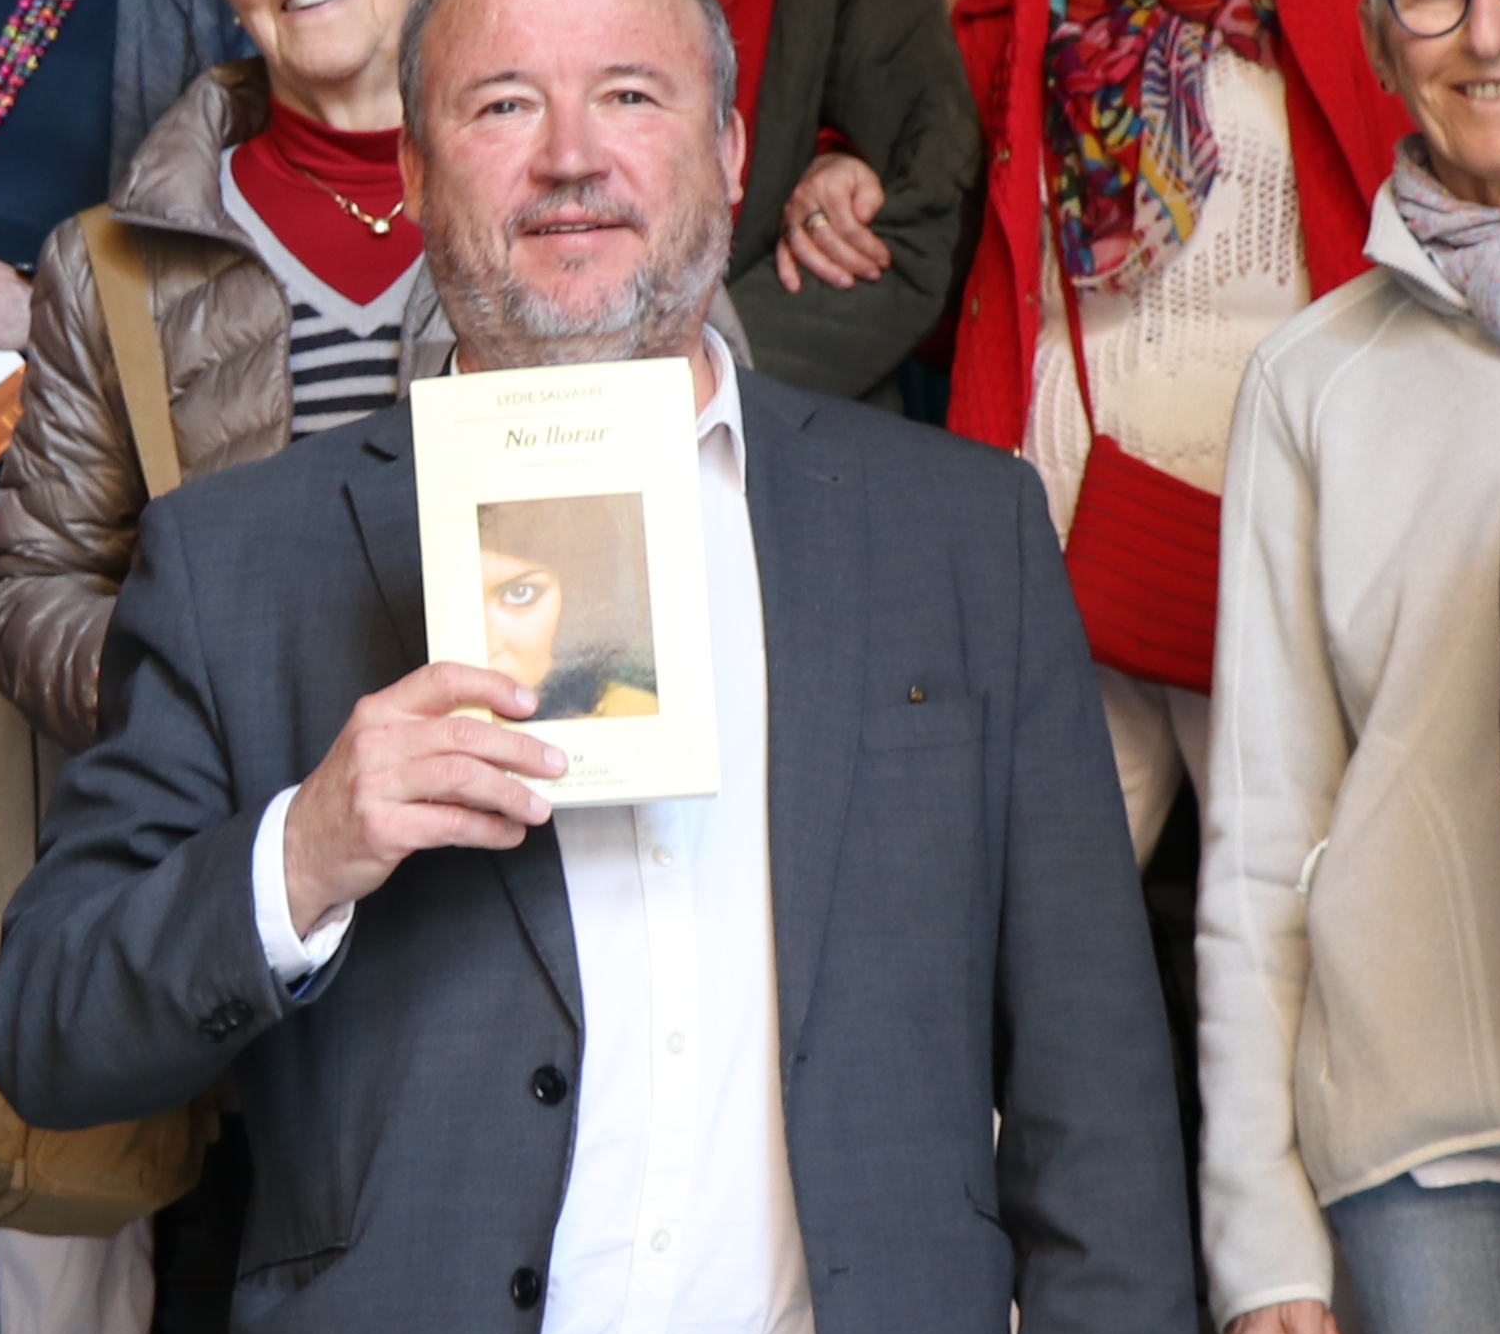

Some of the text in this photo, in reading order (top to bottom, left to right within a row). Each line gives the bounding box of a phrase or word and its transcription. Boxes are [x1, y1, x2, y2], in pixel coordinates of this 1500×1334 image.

[496, 385, 605, 407] LYDIE SALVAYRE
[503, 423, 610, 450] No llorar
